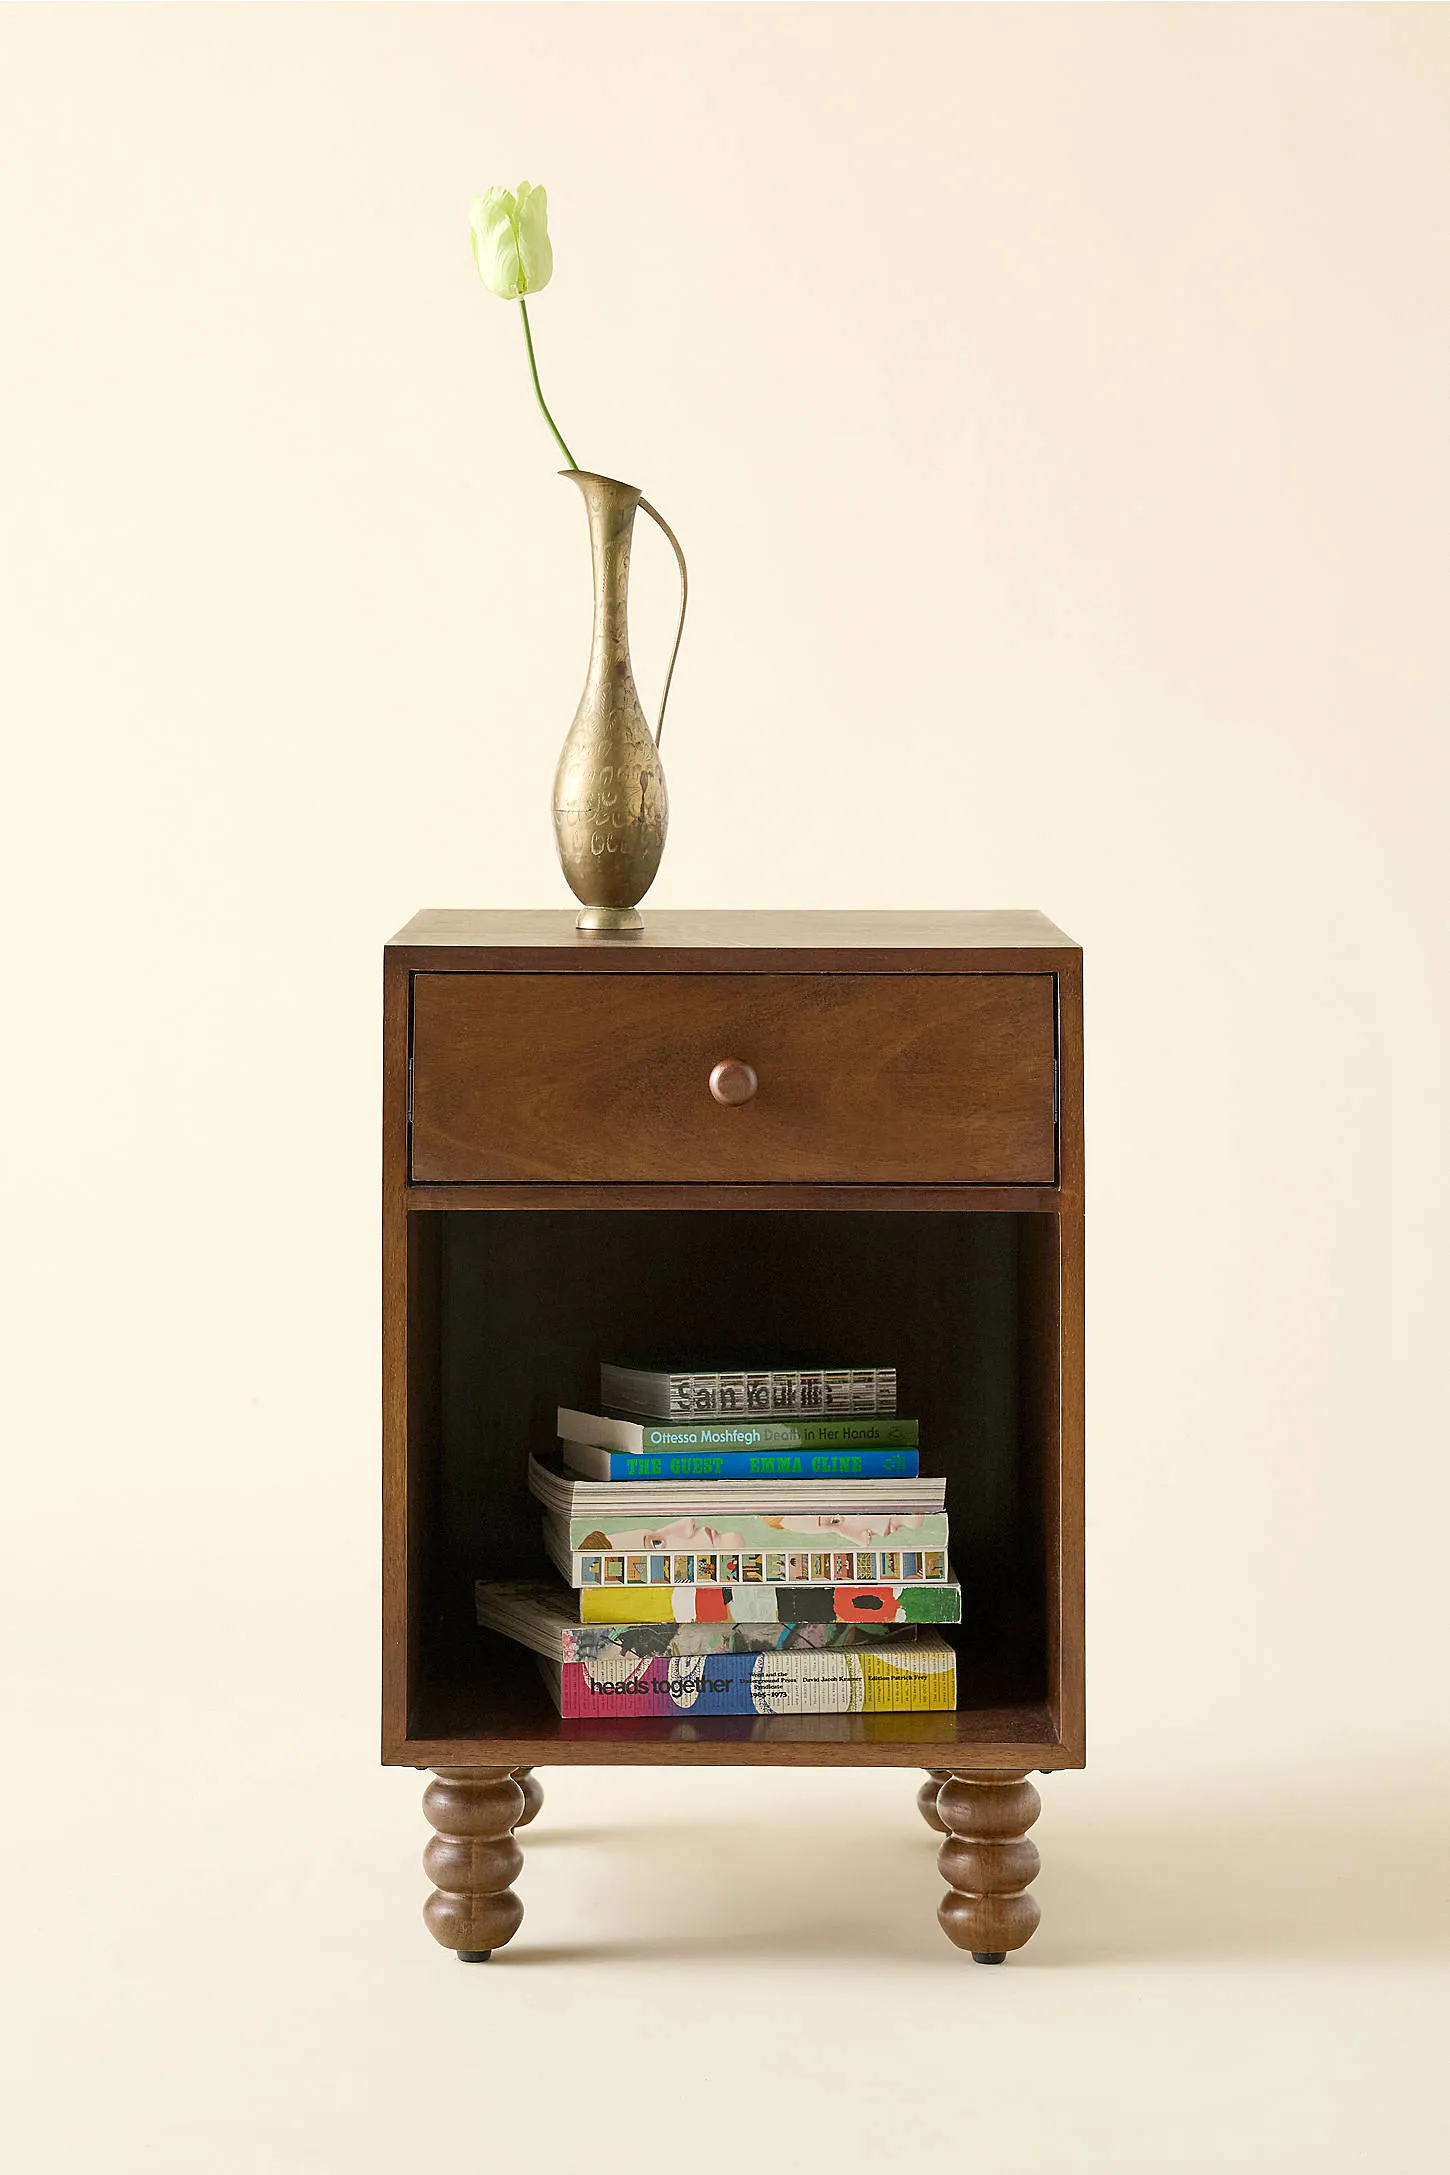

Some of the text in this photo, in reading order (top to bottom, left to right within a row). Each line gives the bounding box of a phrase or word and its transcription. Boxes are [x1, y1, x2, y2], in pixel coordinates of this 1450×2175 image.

[650, 1426, 880, 1445] Ottessa Moshfegh Death in Her Hands
[627, 1455, 862, 1475] THE GUEST EMMA CLINE
[590, 1674, 733, 1698] heads together
